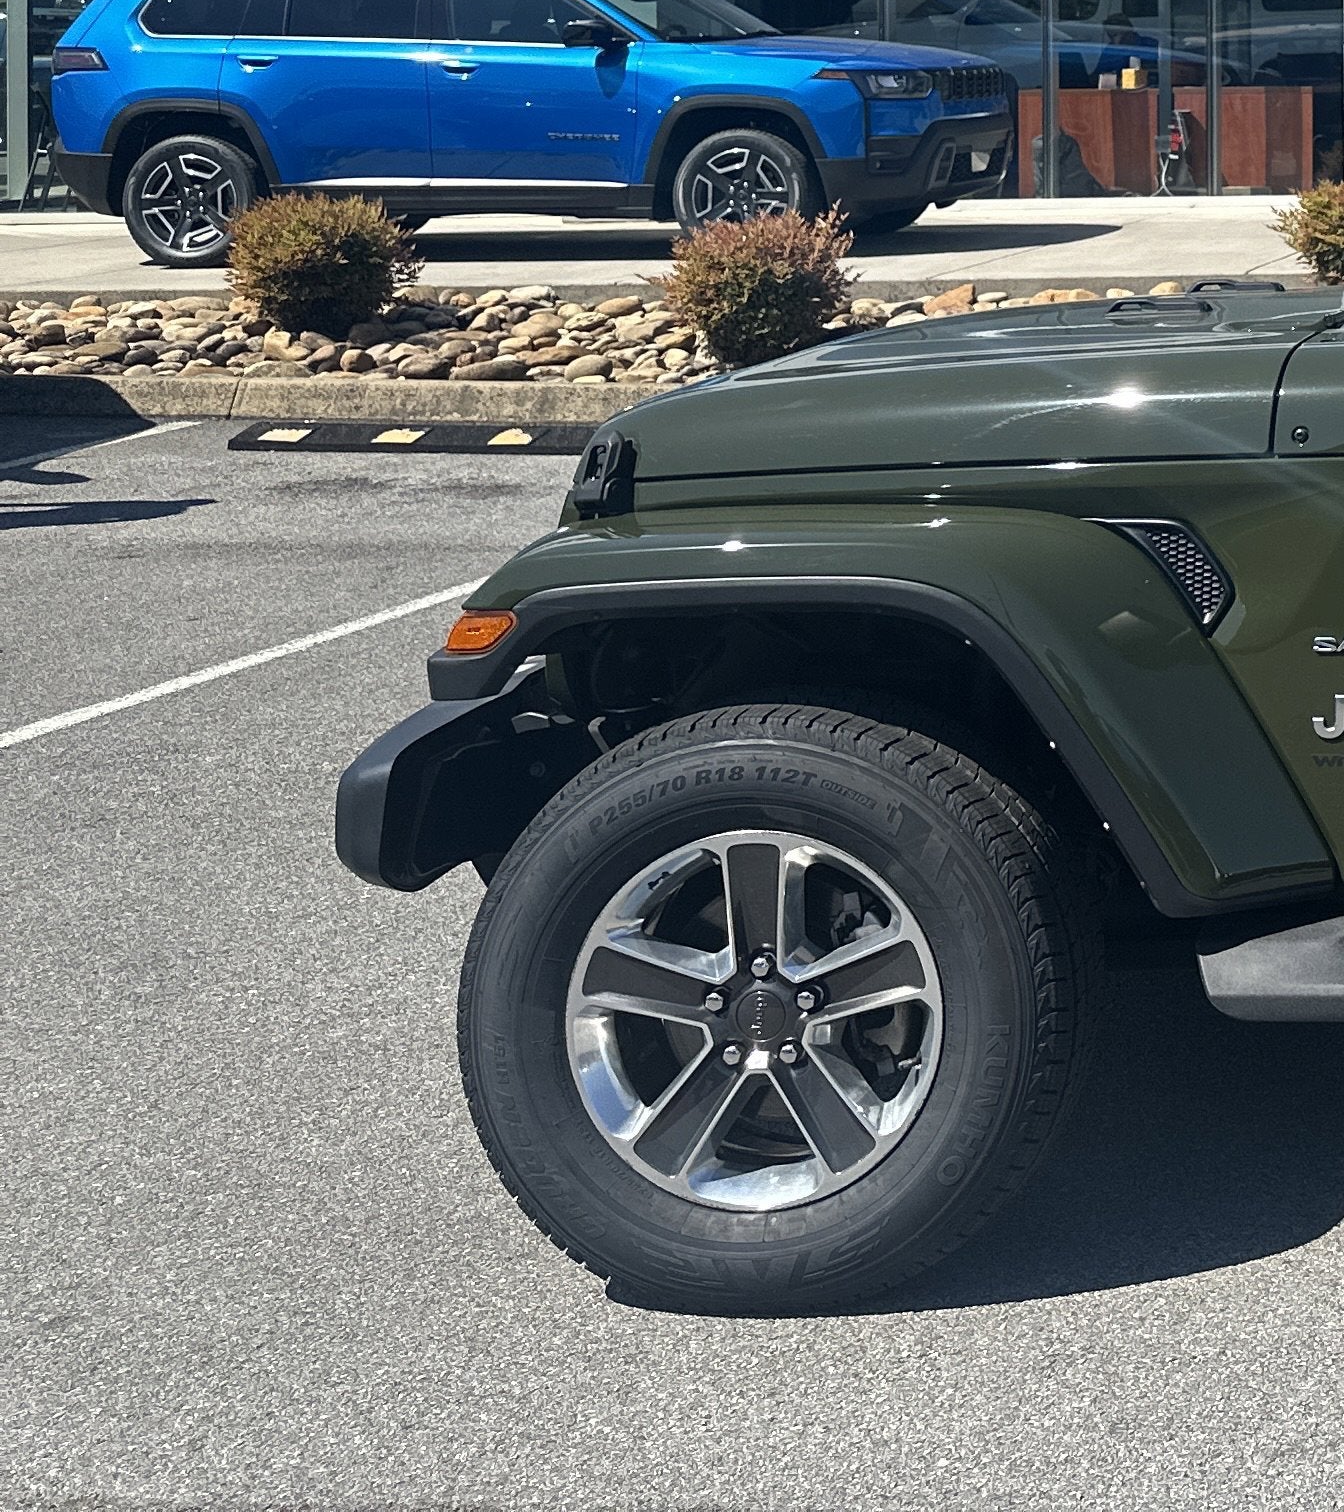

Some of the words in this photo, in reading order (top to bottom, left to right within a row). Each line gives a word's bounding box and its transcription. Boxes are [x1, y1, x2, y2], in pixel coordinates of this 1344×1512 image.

[588, 774, 688, 834] P255/70
[694, 765, 745, 787] R18
[755, 765, 818, 787] 112T
[820, 778, 877, 810] OUTSIDE
[936, 1024, 1011, 1186] KUMHO
